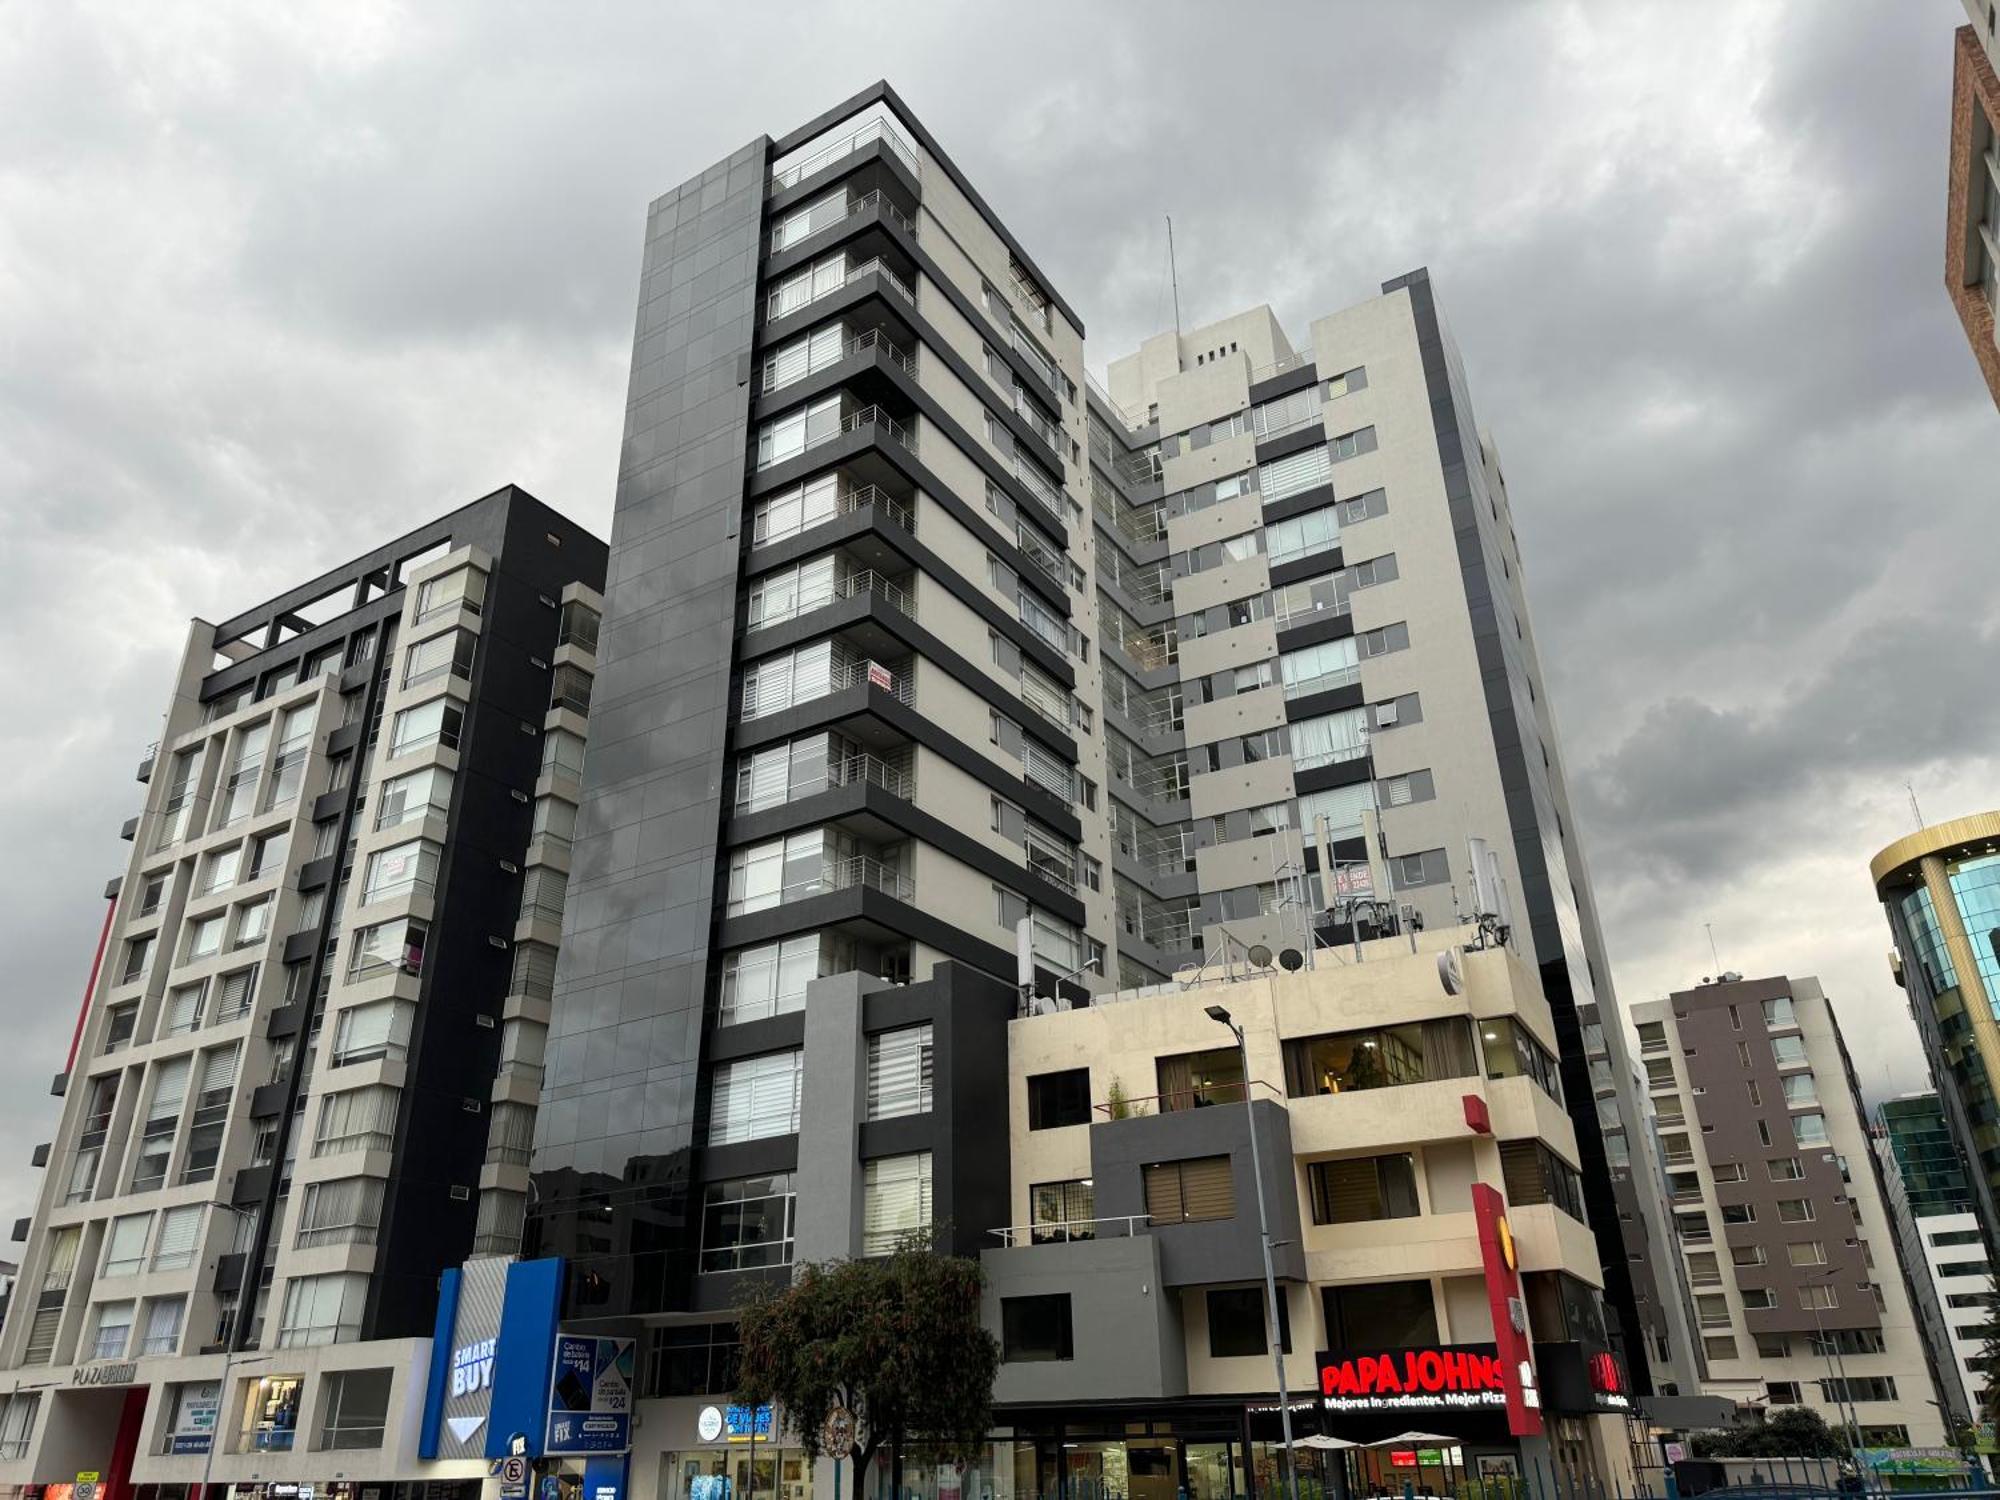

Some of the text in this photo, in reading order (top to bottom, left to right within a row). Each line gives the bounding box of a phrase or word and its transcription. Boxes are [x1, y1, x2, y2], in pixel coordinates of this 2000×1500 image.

[454, 1338, 497, 1368] SMART
[453, 1358, 494, 1398] BUY
[1321, 1353, 1402, 1395] PAPA
[609, 1396, 626, 1409] $24
[1324, 1397, 1370, 1411] Mejores
[1445, 1393, 1482, 1407] Mejor
[1482, 1391, 1507, 1404] Pizz
[555, 1428, 571, 1443] FIX
